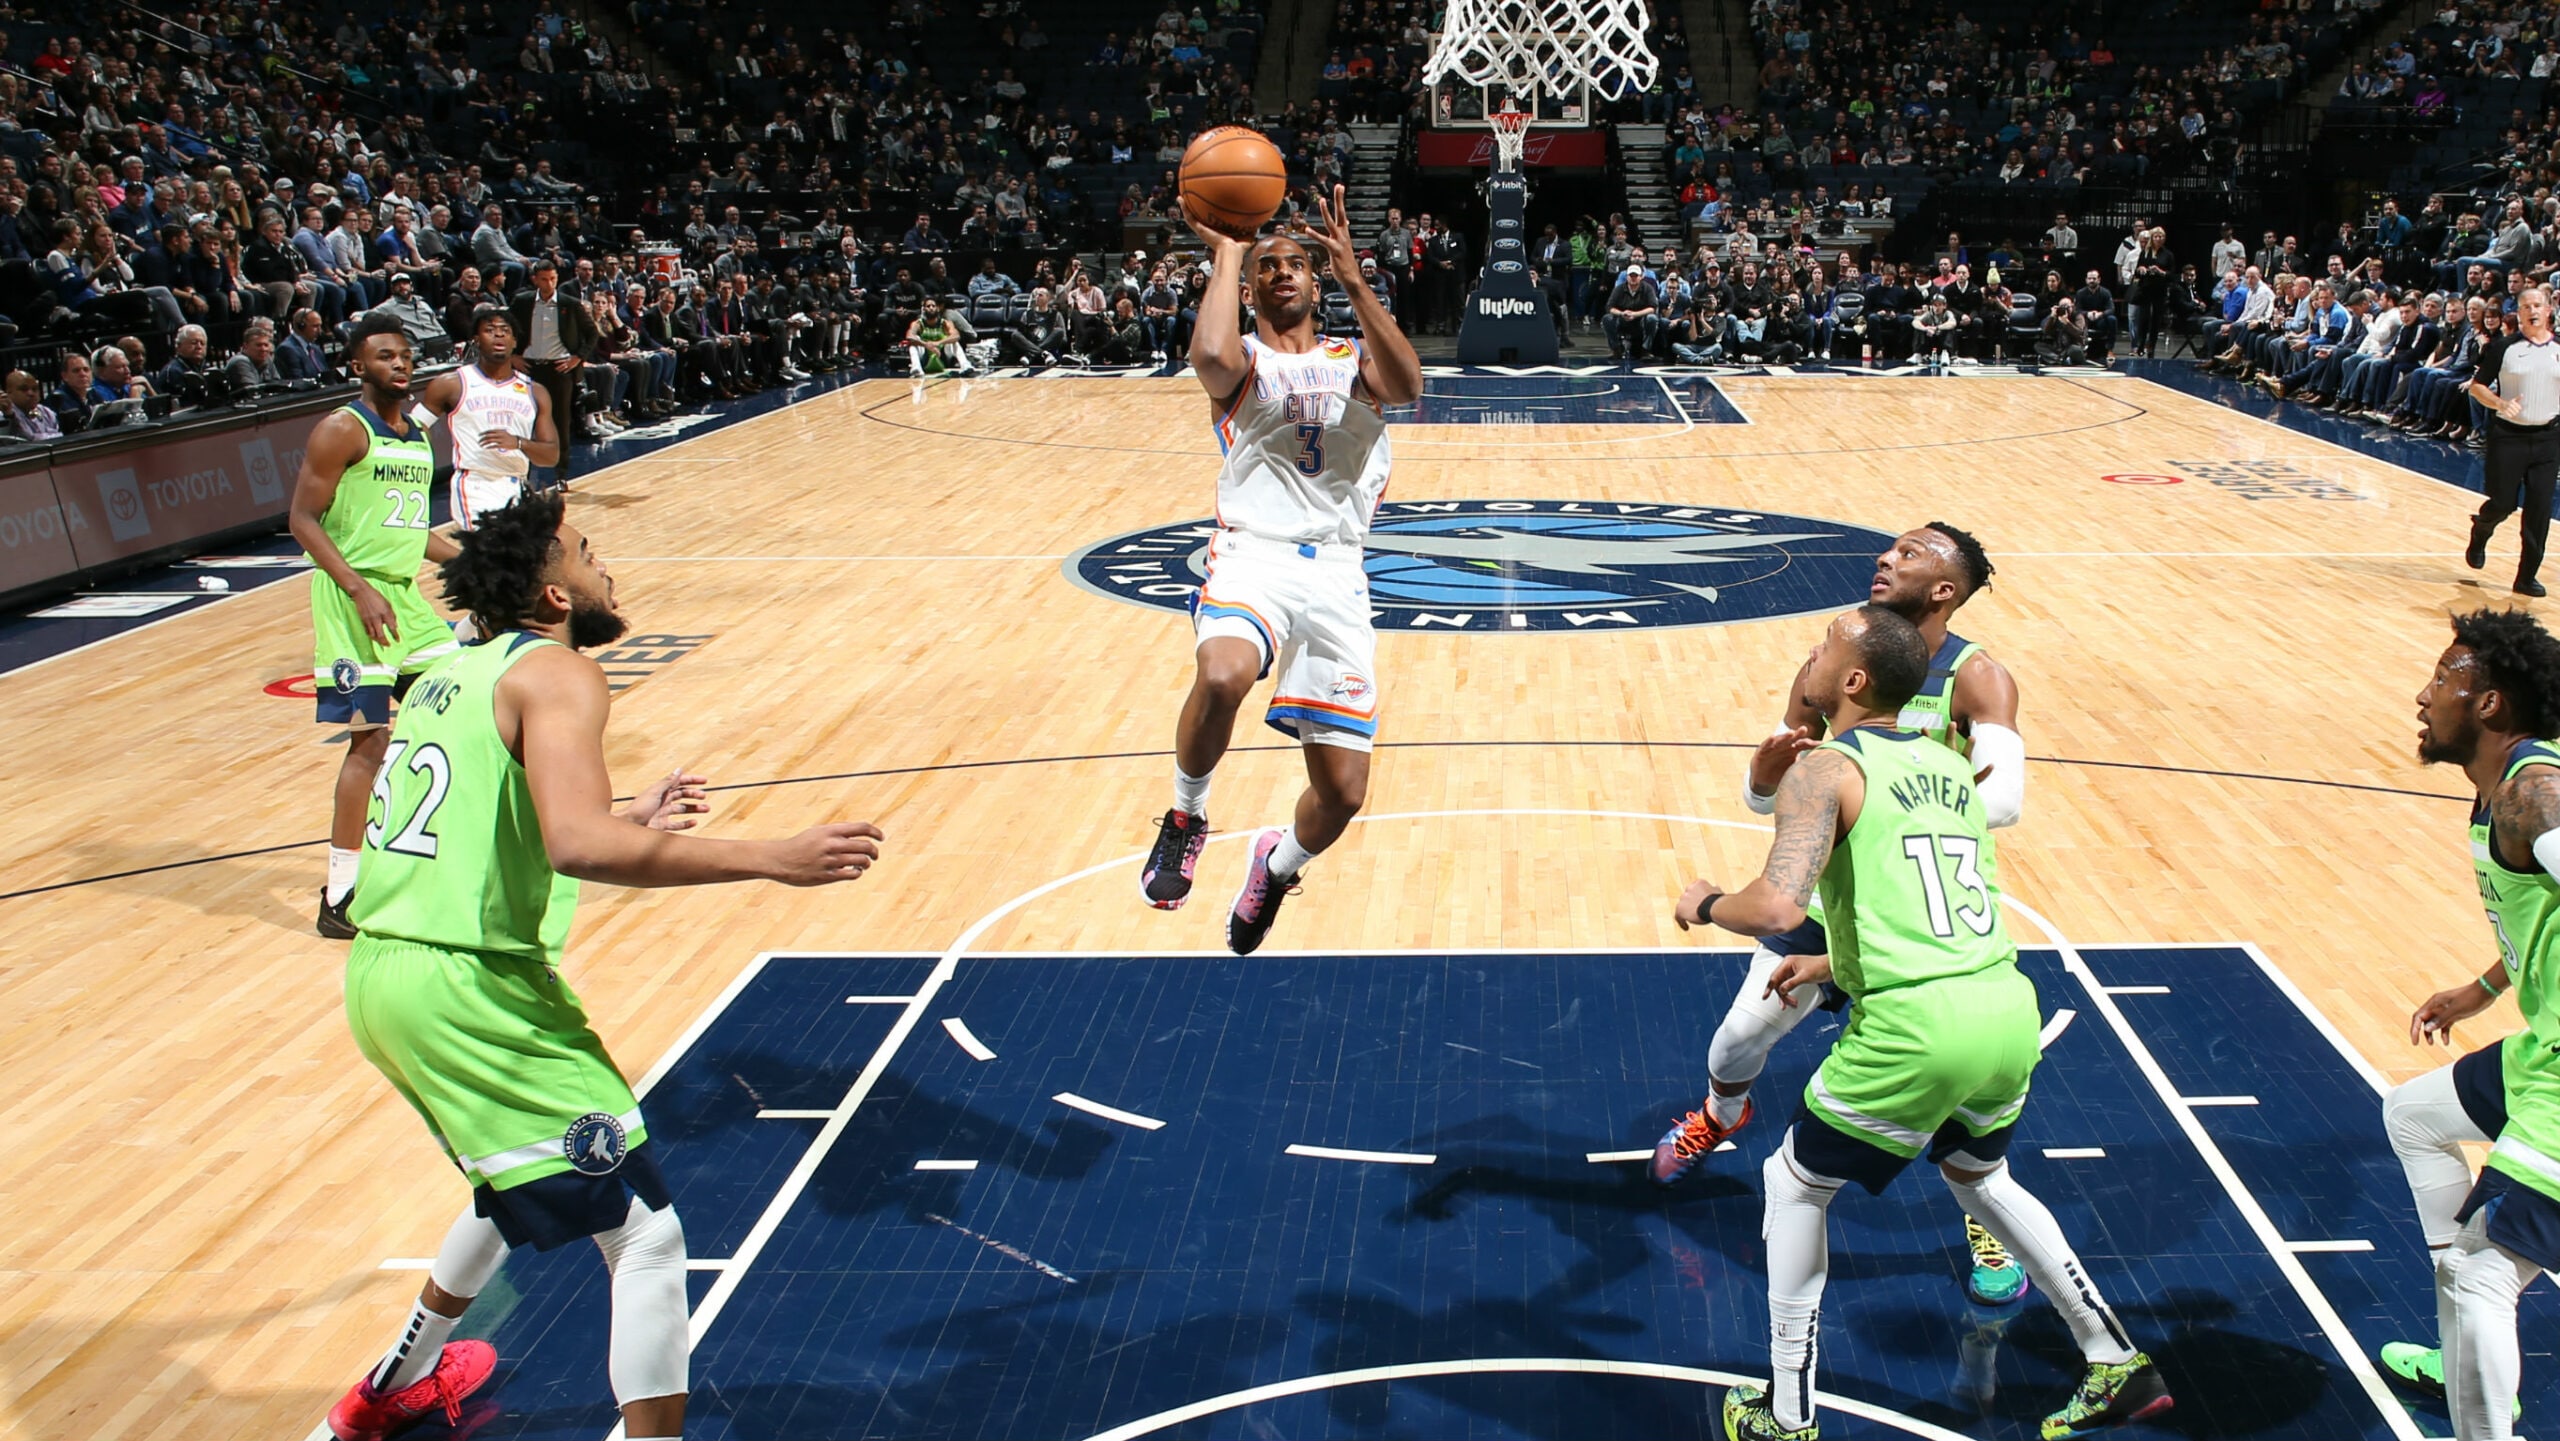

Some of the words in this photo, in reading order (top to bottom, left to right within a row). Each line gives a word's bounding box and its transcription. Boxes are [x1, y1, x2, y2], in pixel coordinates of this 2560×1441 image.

[1501, 181, 1522, 189] fitbit
[1498, 262, 1518, 271] Ford
[465, 396, 532, 417] OKLAHOMA
[487, 410, 515, 427] CITY
[1284, 392, 1334, 422] CITY
[1295, 421, 1325, 477] 3
[148, 467, 233, 511] TOYOTA
[2165, 460, 2298, 500] TARGET
[2228, 460, 2369, 501] CENTER
[0, 501, 89, 549] OYOTA
[382, 488, 429, 529] 22
[405, 679, 462, 717] TOWNS
[1915, 699, 1938, 710] fitbit
[366, 739, 452, 860] 32
[1889, 773, 1970, 817] NAPIER
[1902, 833, 1994, 937] 13
